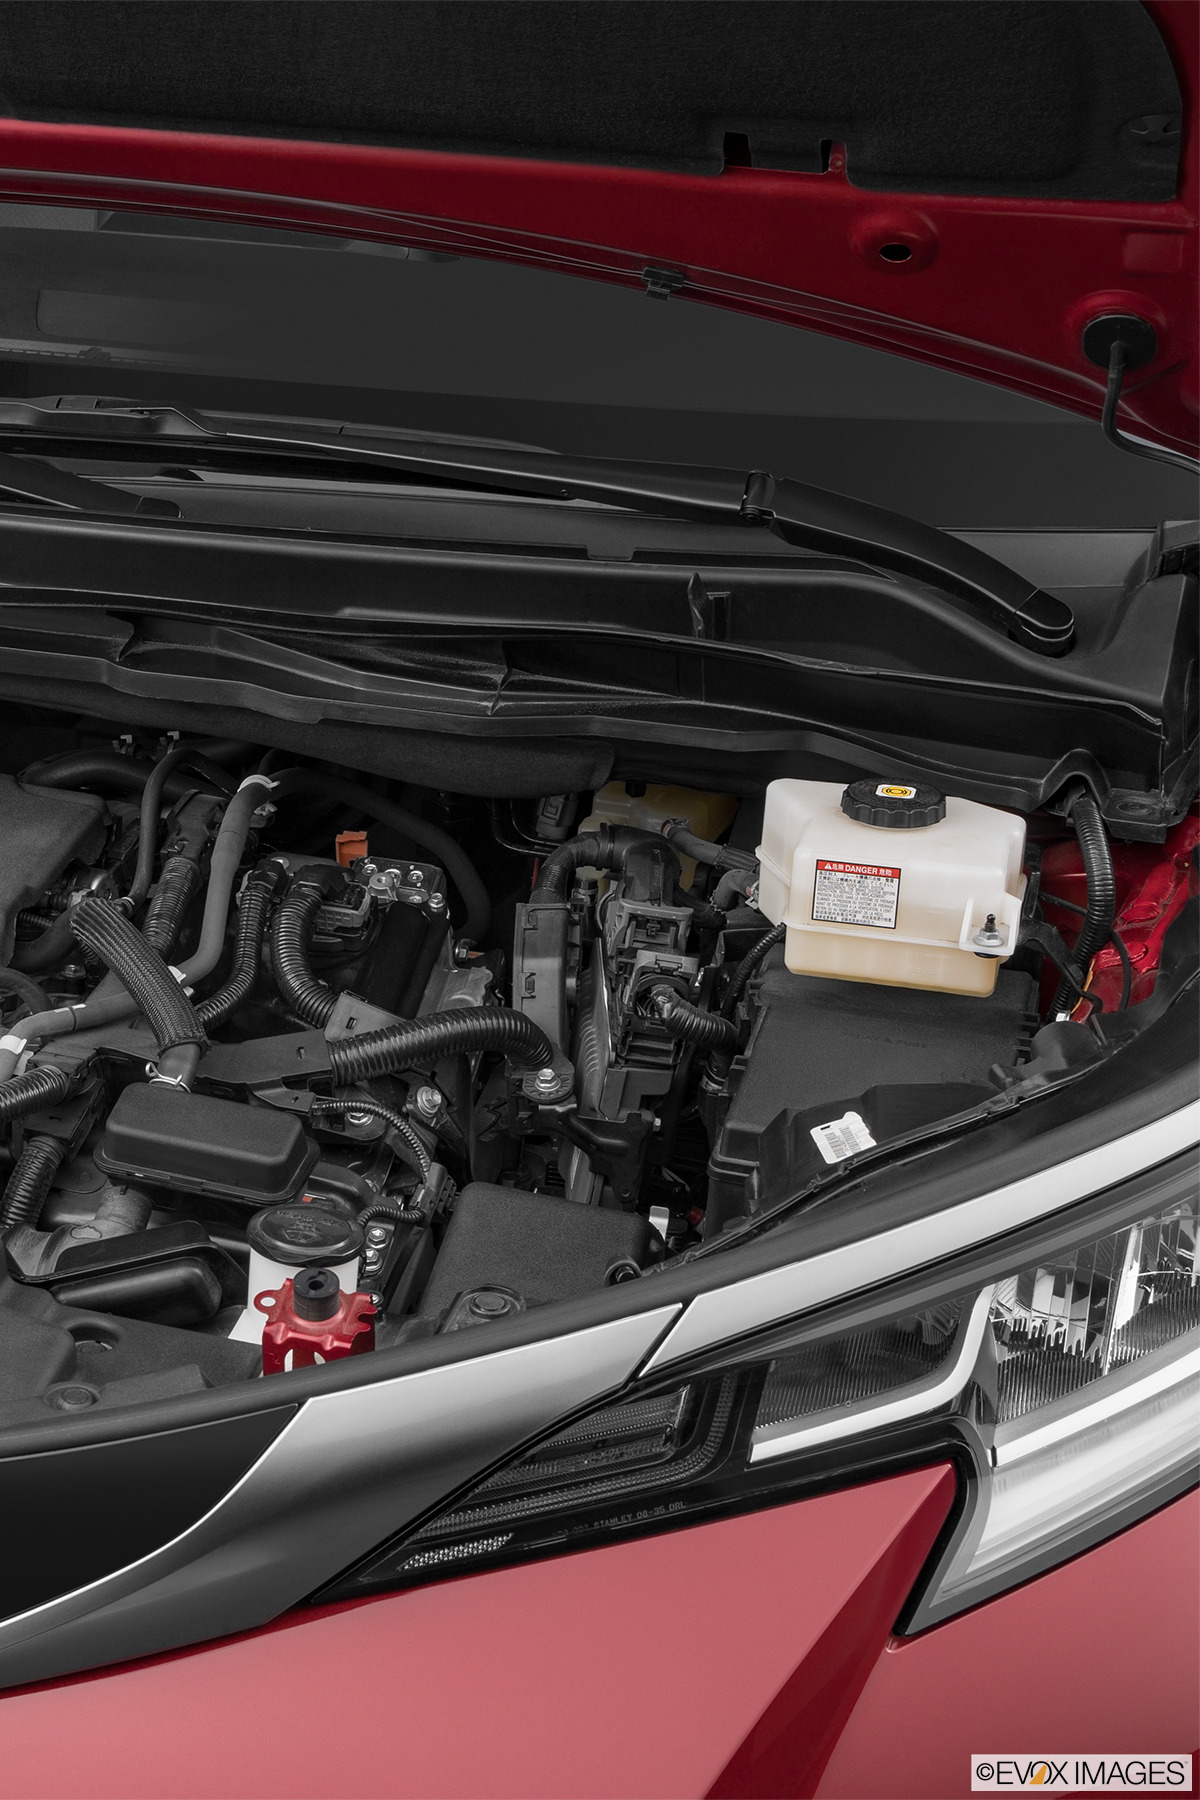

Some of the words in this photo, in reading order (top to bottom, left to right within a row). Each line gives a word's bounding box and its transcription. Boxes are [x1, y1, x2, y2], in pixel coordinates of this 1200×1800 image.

[845, 864, 878, 874] DANGER
[593, 1513, 633, 1529] STANLEY
[668, 1501, 687, 1512] DRL
